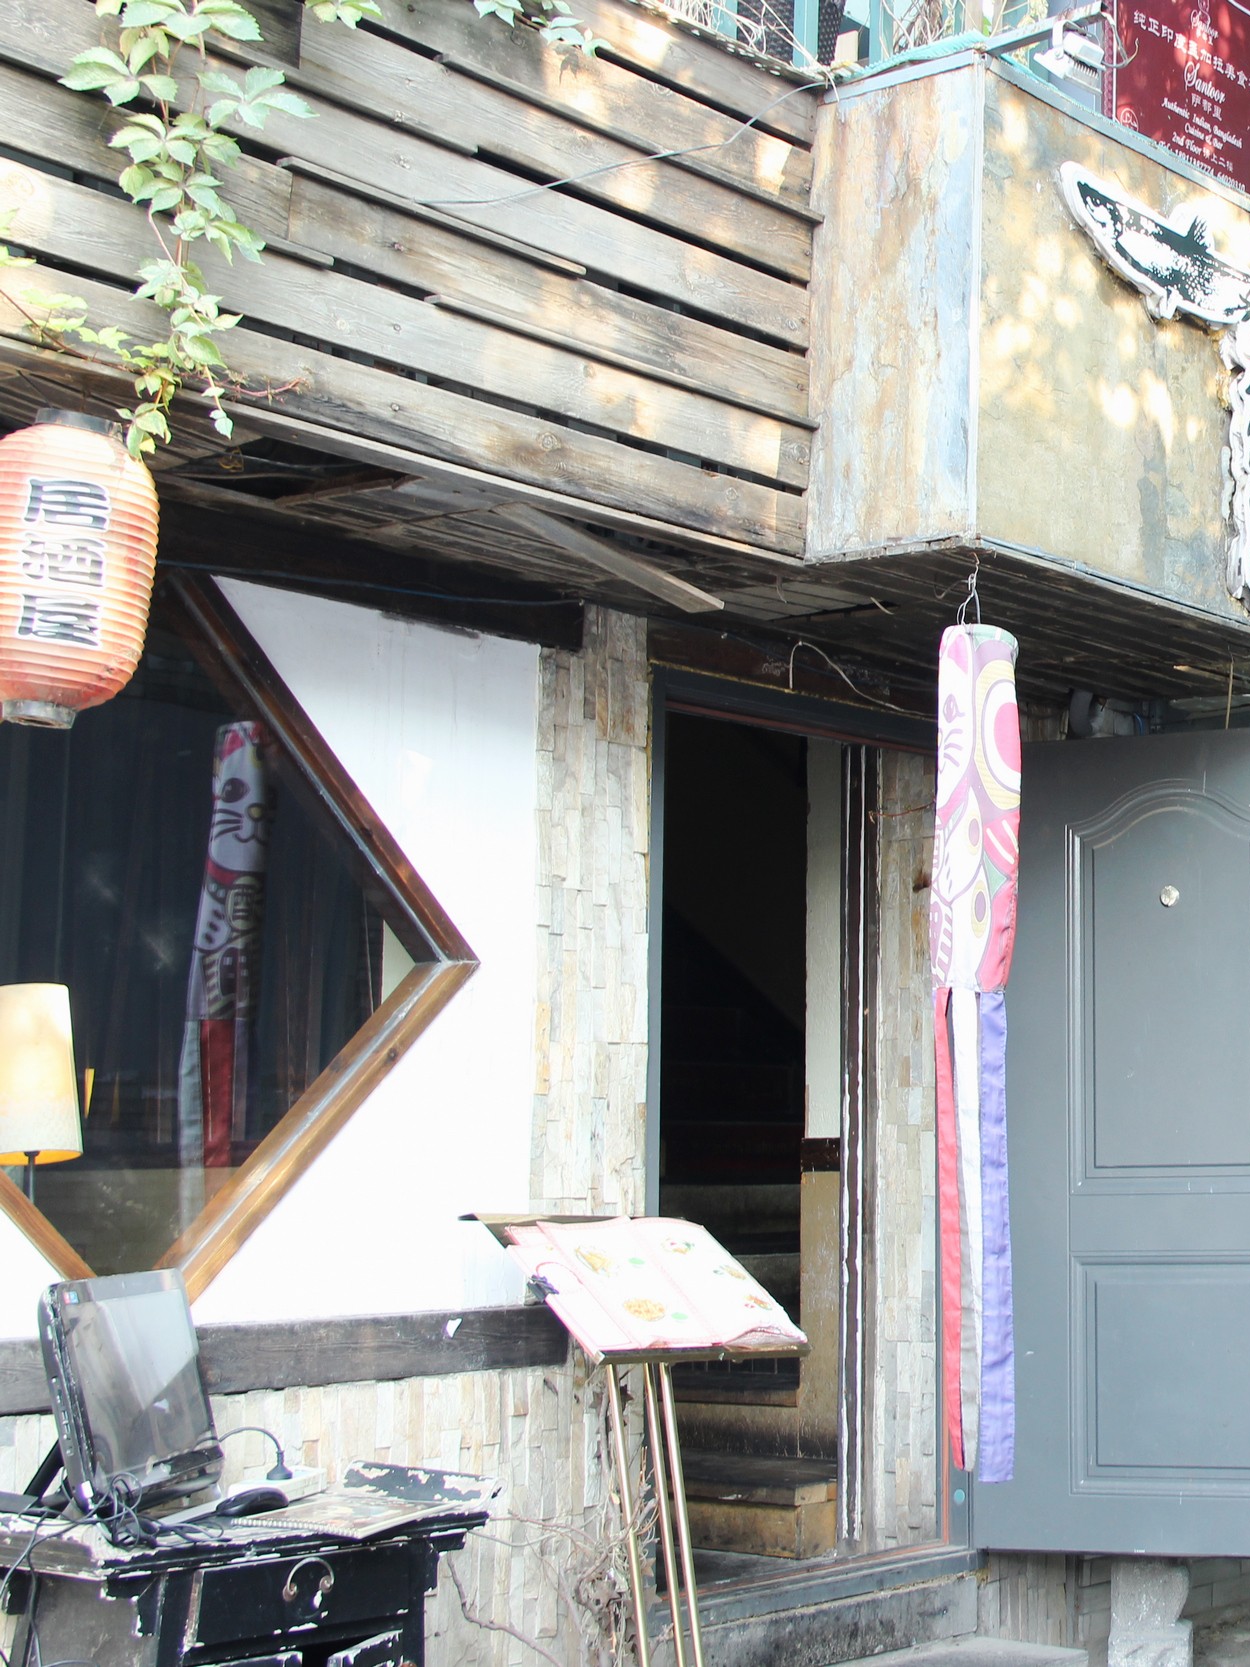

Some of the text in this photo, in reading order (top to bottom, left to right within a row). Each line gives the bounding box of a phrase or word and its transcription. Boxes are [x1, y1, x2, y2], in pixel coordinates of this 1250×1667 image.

[1184, 61, 1225, 104] Santoor
[1162, 97, 1190, 119] Authentic
[1213, 125, 1242, 149] Bangladesh
[1172, 131, 1186, 147] 2nd
[1185, 138, 1203, 156] Floor
[1185, 122, 1205, 140] Cuisine
[1213, 137, 1224, 150] Bar
[19, 478, 110, 647] 居酒屋
